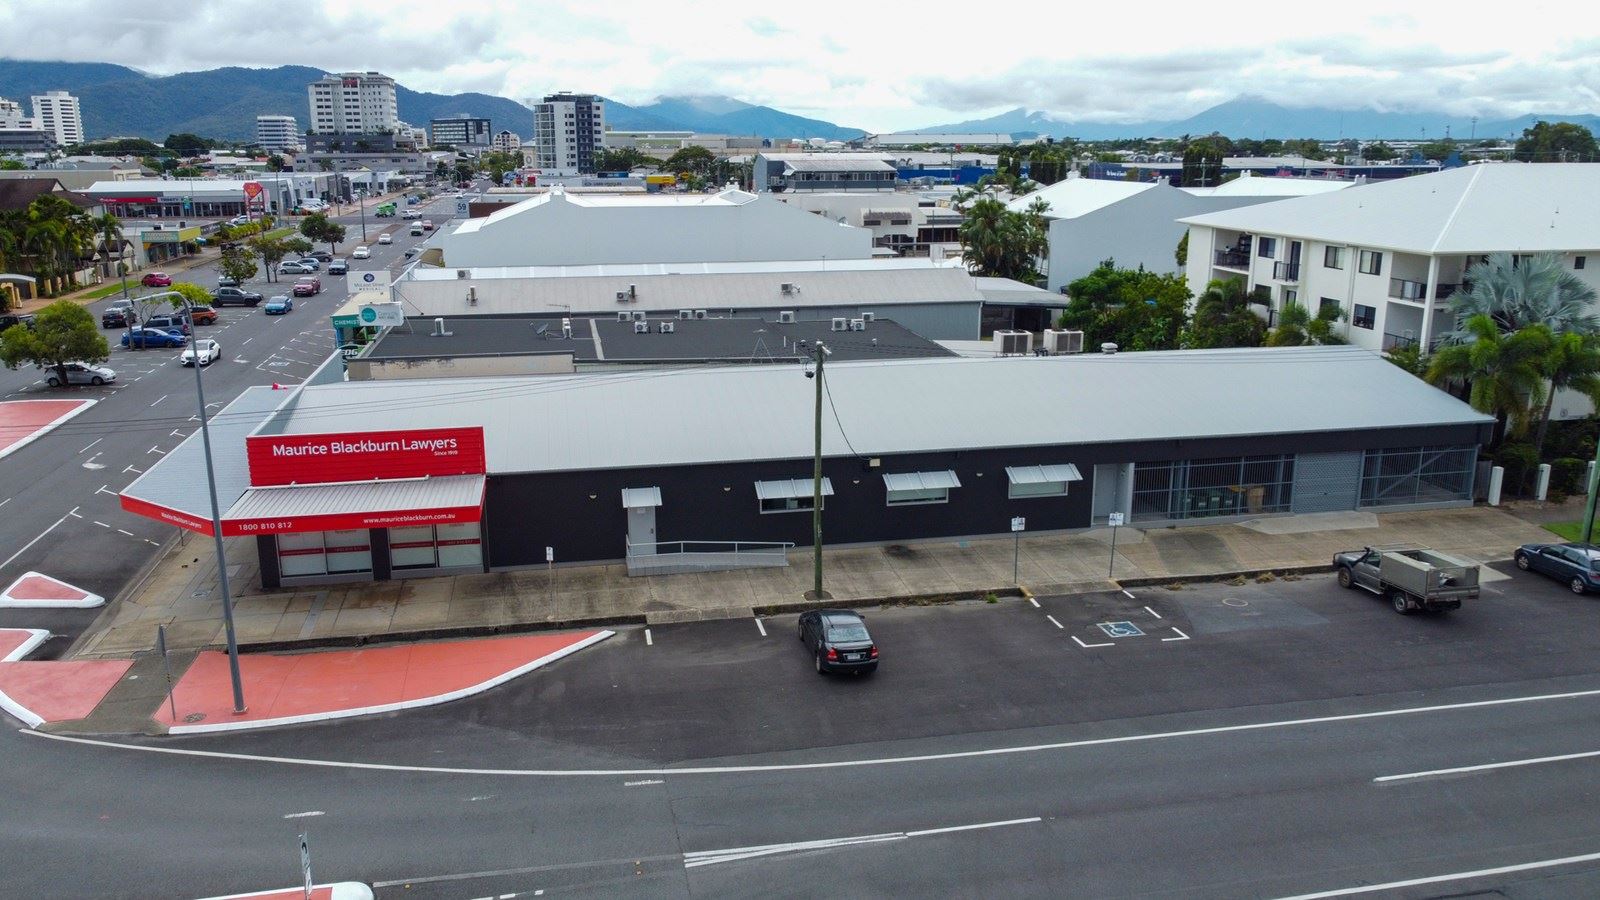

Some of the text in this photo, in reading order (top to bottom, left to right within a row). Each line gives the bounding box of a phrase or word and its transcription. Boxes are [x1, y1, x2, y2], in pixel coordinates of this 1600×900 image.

[457, 203, 467, 211] 59
[272, 438, 457, 457] Maurice Blackburn Lawyers
[363, 513, 456, 524] www.mauriceblackburn.com.au
[238, 521, 293, 531] 1800 810 812
